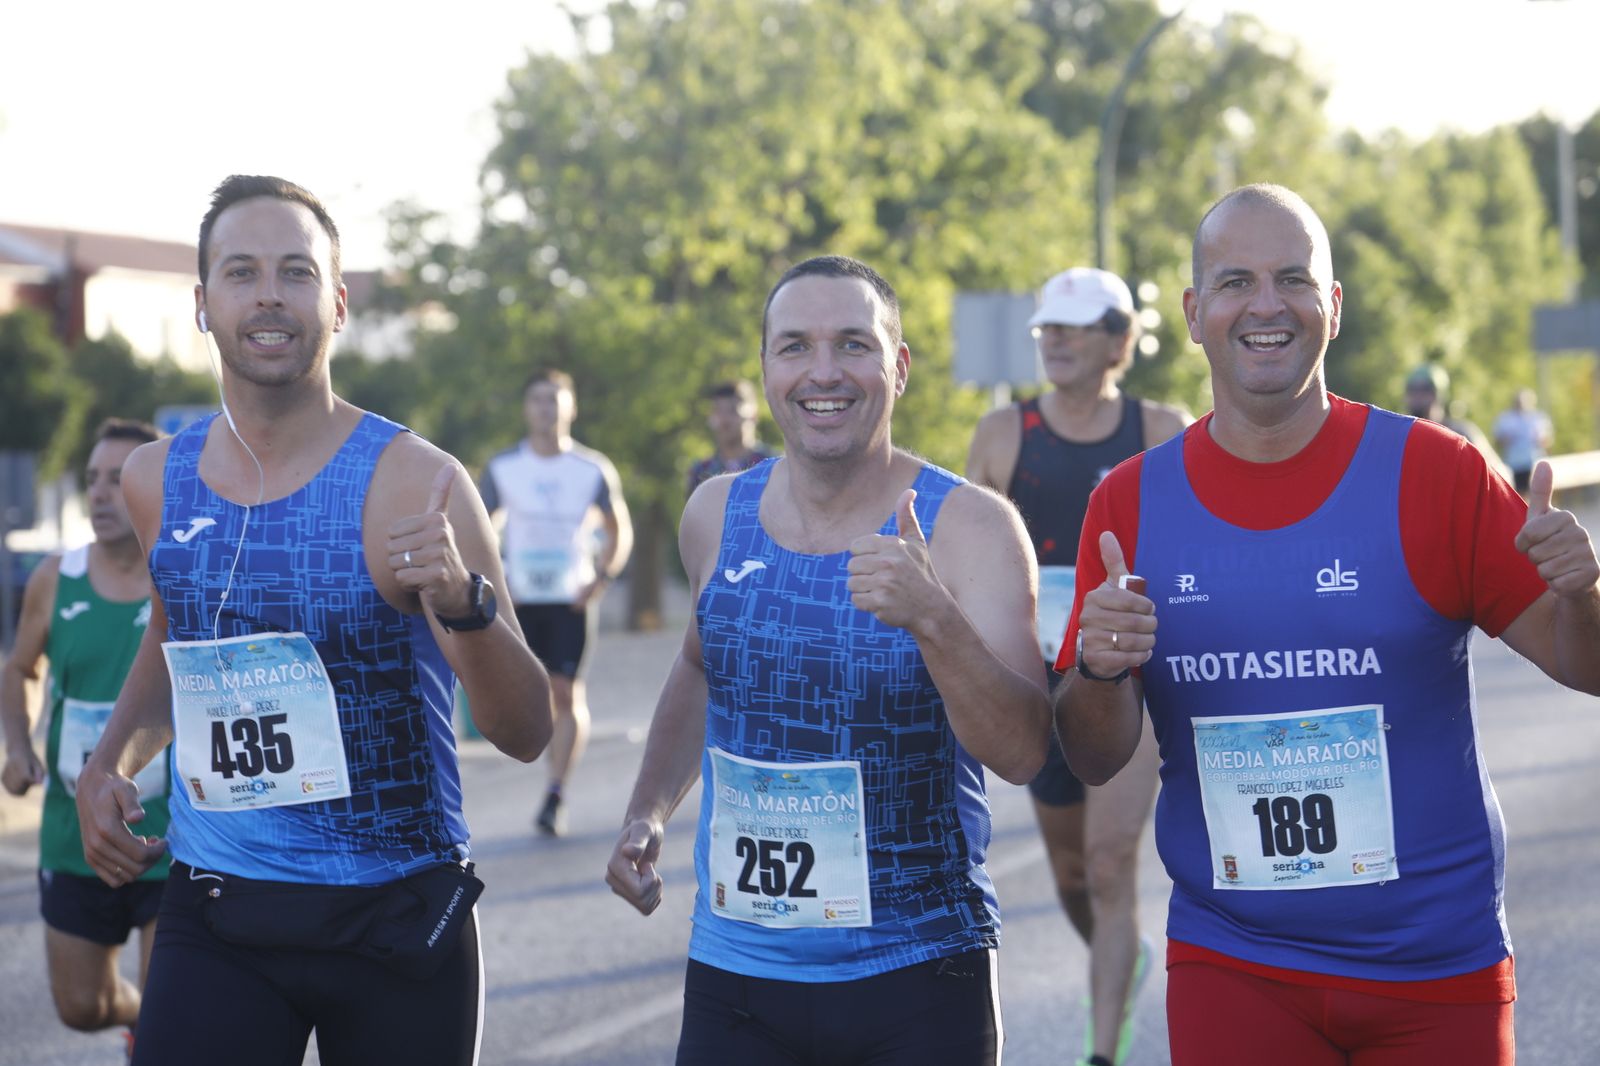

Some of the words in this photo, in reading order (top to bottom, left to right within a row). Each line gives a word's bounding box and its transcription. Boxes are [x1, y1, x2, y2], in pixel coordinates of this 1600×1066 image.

[1315, 559, 1360, 593] als
[1168, 594, 1210, 605] RUNOPRO
[177, 673, 217, 692] MEDIA
[221, 657, 322, 691] MARATÓN
[1166, 647, 1382, 683] TROTASIERRA
[282, 684, 302, 697] DEL
[211, 713, 294, 779] 435
[1203, 750, 1265, 769] MEDIA
[1272, 736, 1377, 766] MARATÓN
[1334, 763, 1356, 775] DEL
[1359, 757, 1380, 770] RÍO
[1237, 782, 1275, 795] FRANCISCO
[1277, 780, 1303, 793] LOPEZ
[1305, 777, 1344, 791] MIGUELES
[757, 790, 856, 813] MARATÓN
[812, 814, 833, 826] DEL
[836, 811, 857, 823] RÍO
[1252, 793, 1337, 857] 189
[760, 826, 783, 838] LOPEZ
[784, 827, 809, 839] PEREZ
[735, 836, 818, 898] 252
[1272, 860, 1325, 872] serizona
[446, 886, 464, 915] SPORTS
